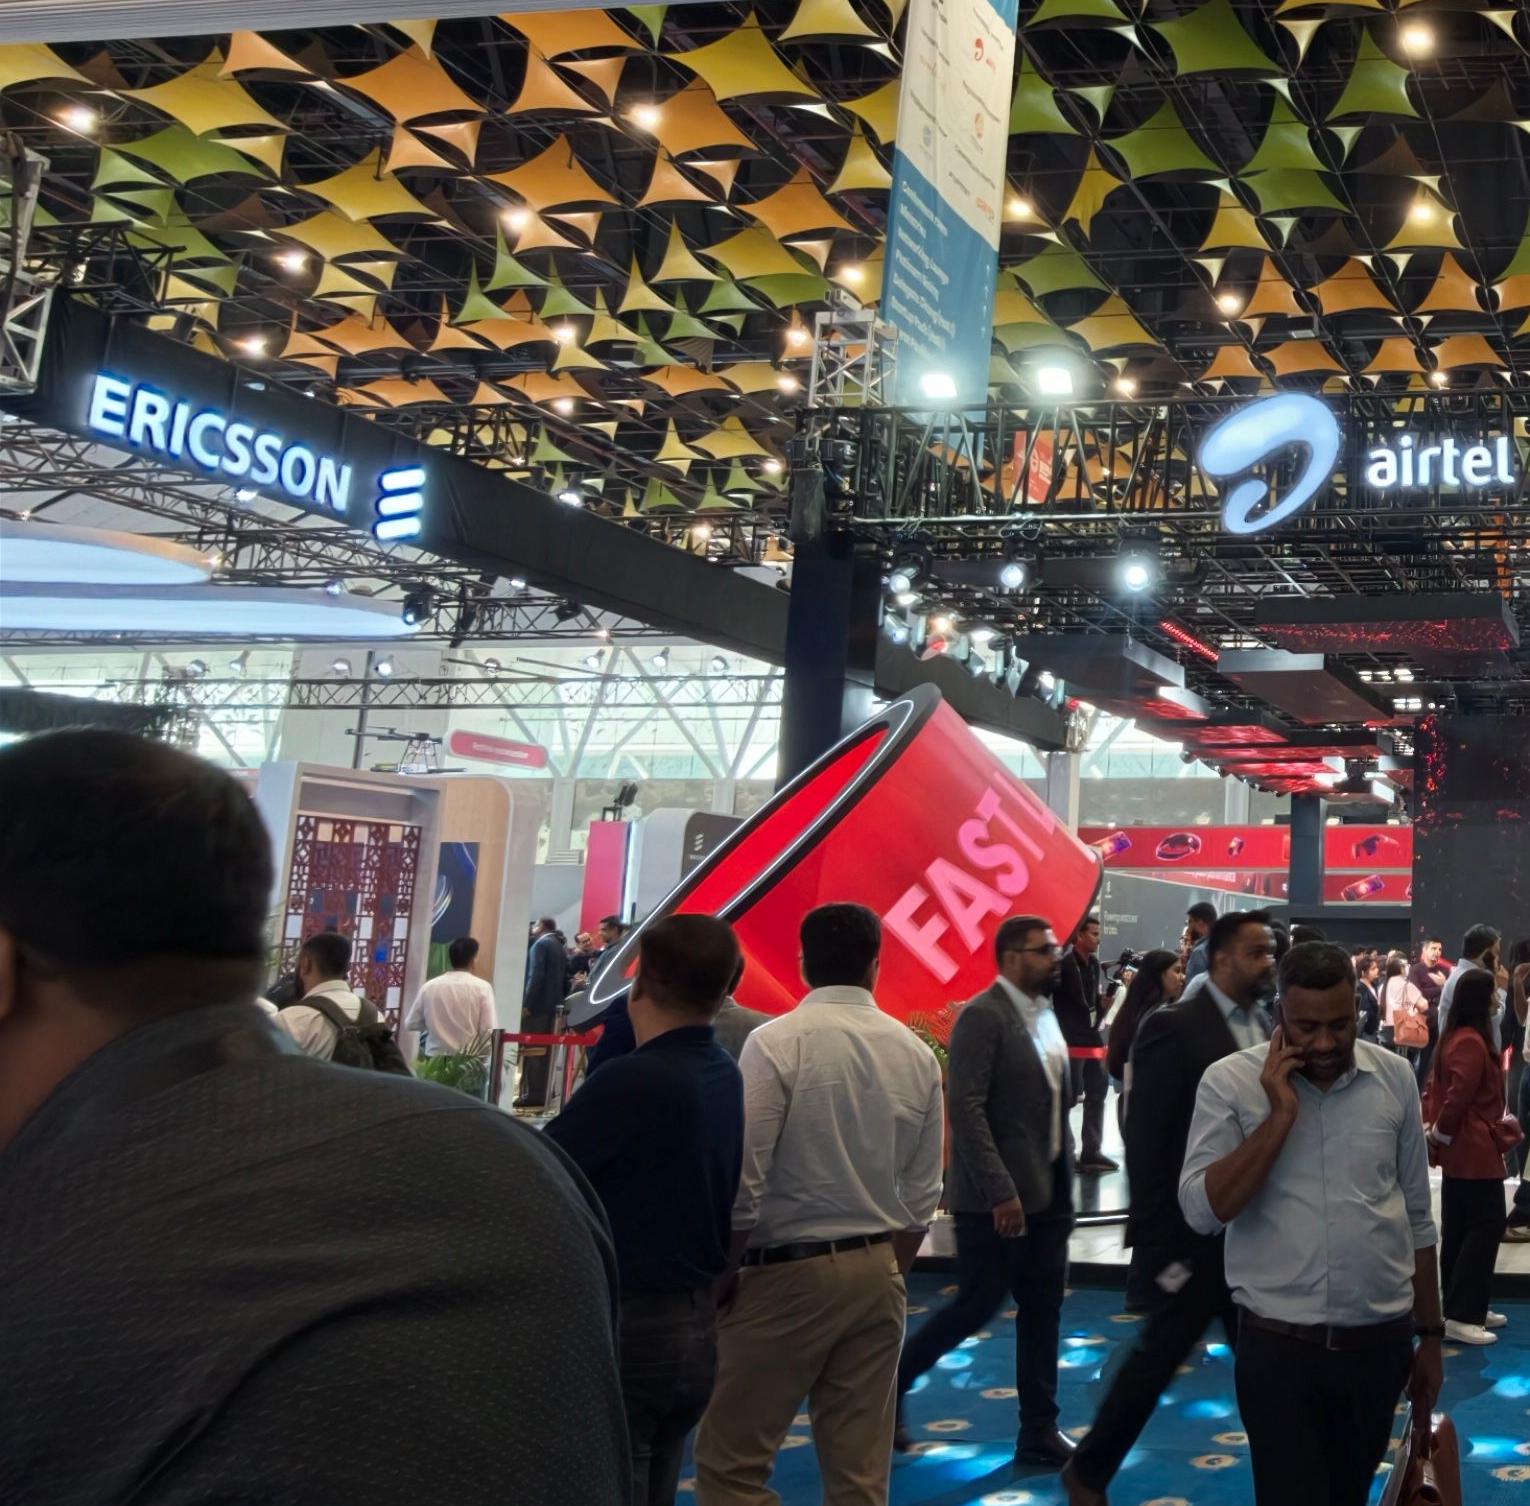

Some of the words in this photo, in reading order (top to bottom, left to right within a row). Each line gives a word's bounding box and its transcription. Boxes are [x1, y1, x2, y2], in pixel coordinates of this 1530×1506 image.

[88, 371, 352, 514] ERICSSON
[1366, 434, 1516, 489] airtel
[881, 786, 1045, 985] FAST
